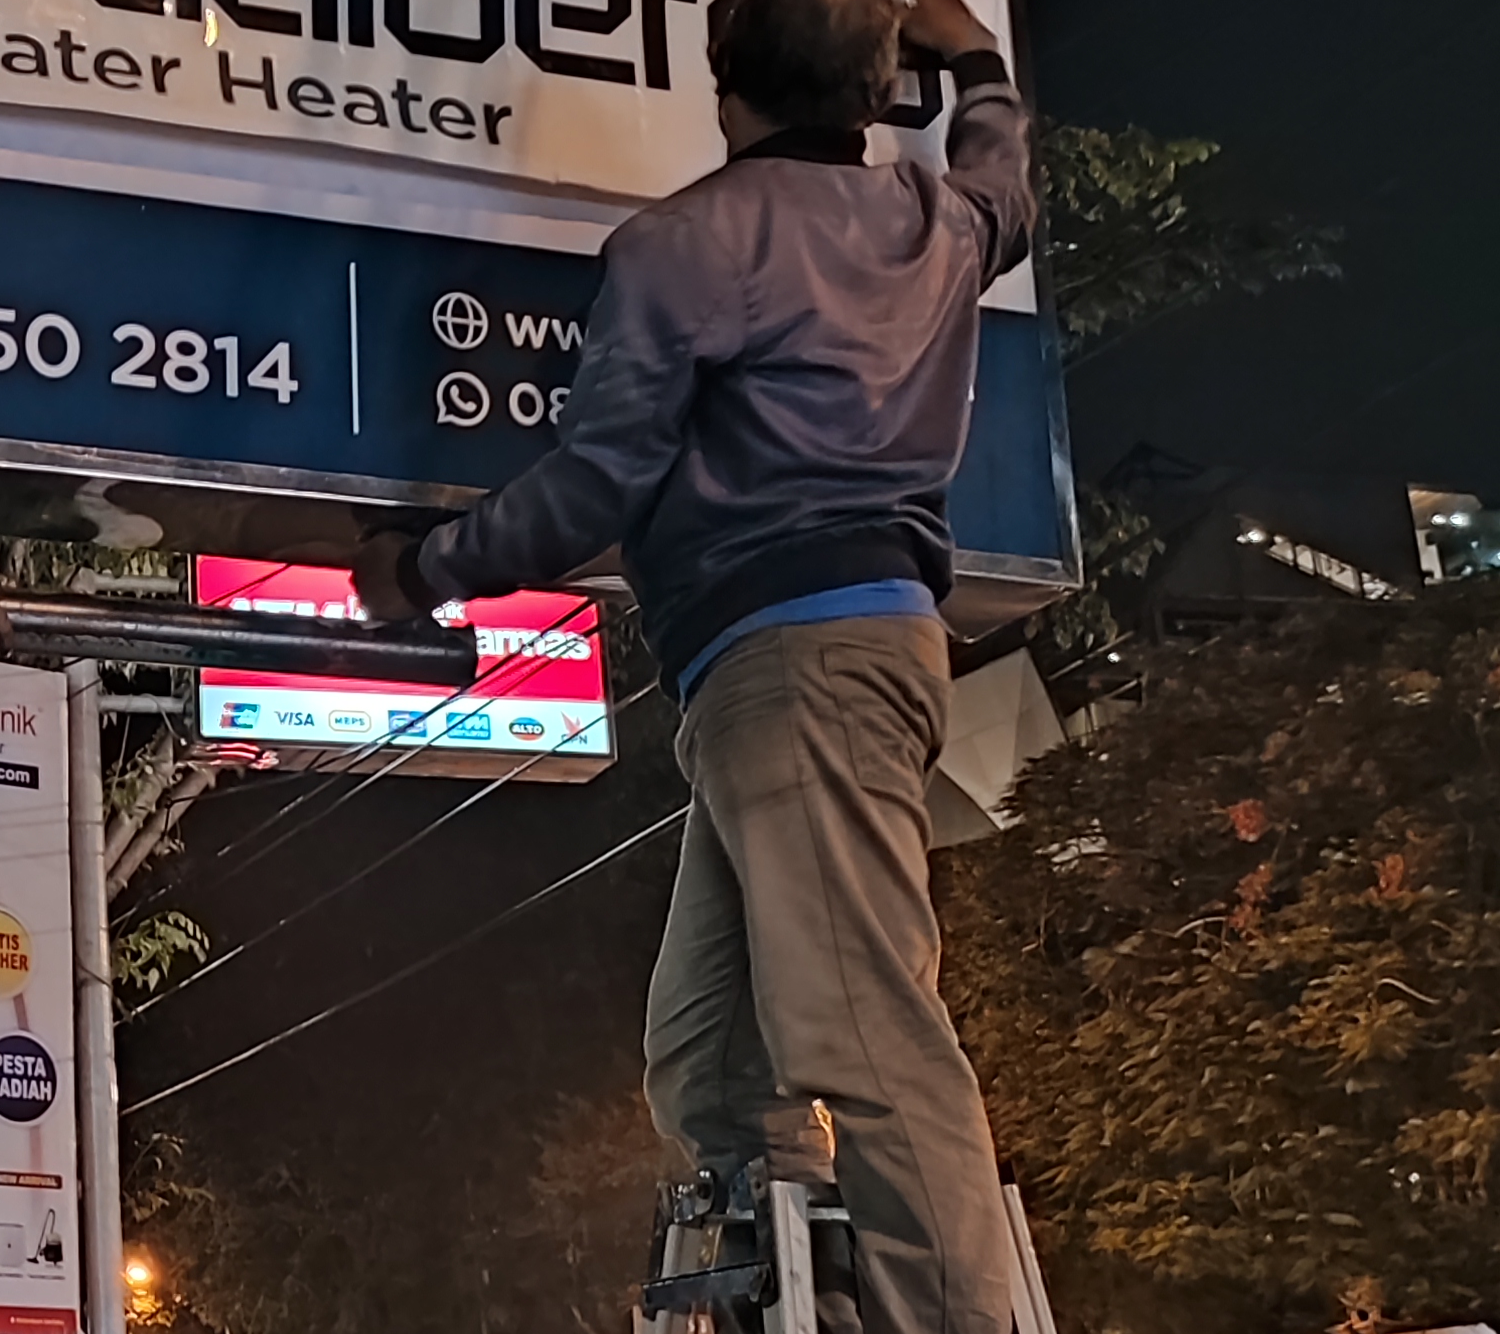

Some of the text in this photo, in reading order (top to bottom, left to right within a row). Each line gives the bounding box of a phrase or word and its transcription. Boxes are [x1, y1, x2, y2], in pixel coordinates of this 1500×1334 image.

[217, 49, 513, 146] Heater
[110, 323, 299, 405] 2814
[274, 710, 315, 727] VISA
[510, 722, 543, 736] ALTO
